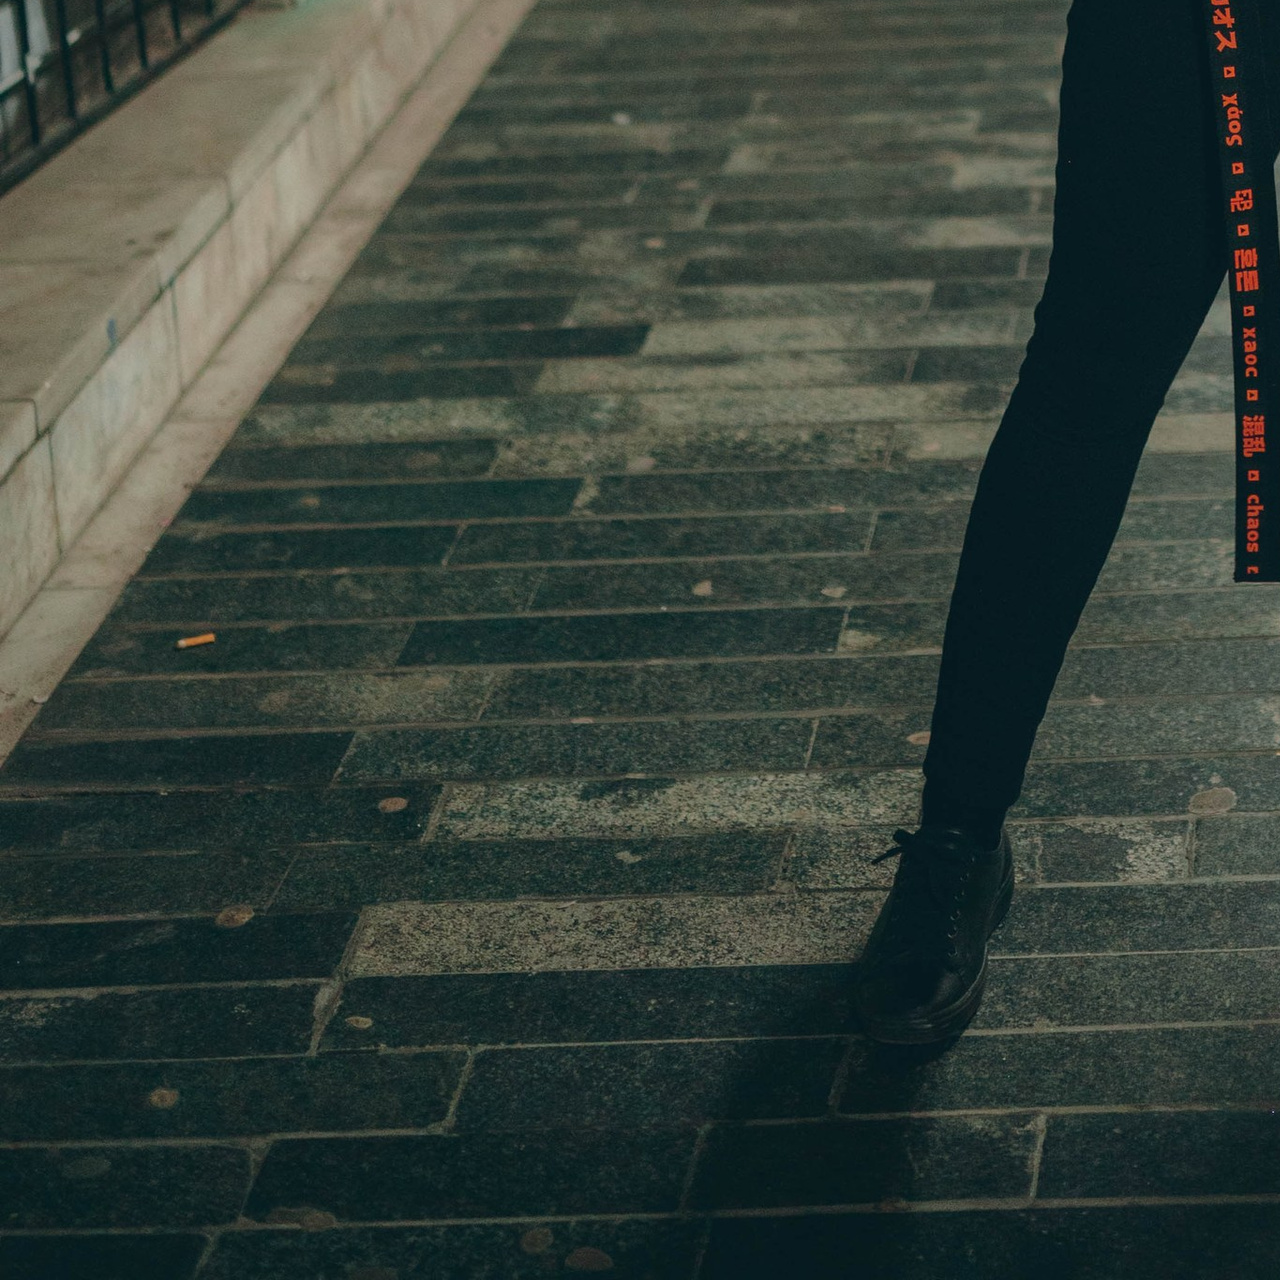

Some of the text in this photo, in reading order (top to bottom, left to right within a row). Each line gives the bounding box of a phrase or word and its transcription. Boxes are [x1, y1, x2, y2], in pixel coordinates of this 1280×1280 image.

[1234, 247, 1260, 293] 혼돈
[1242, 415, 1266, 459] 混乱
[1246, 494, 1264, 554] chaos
